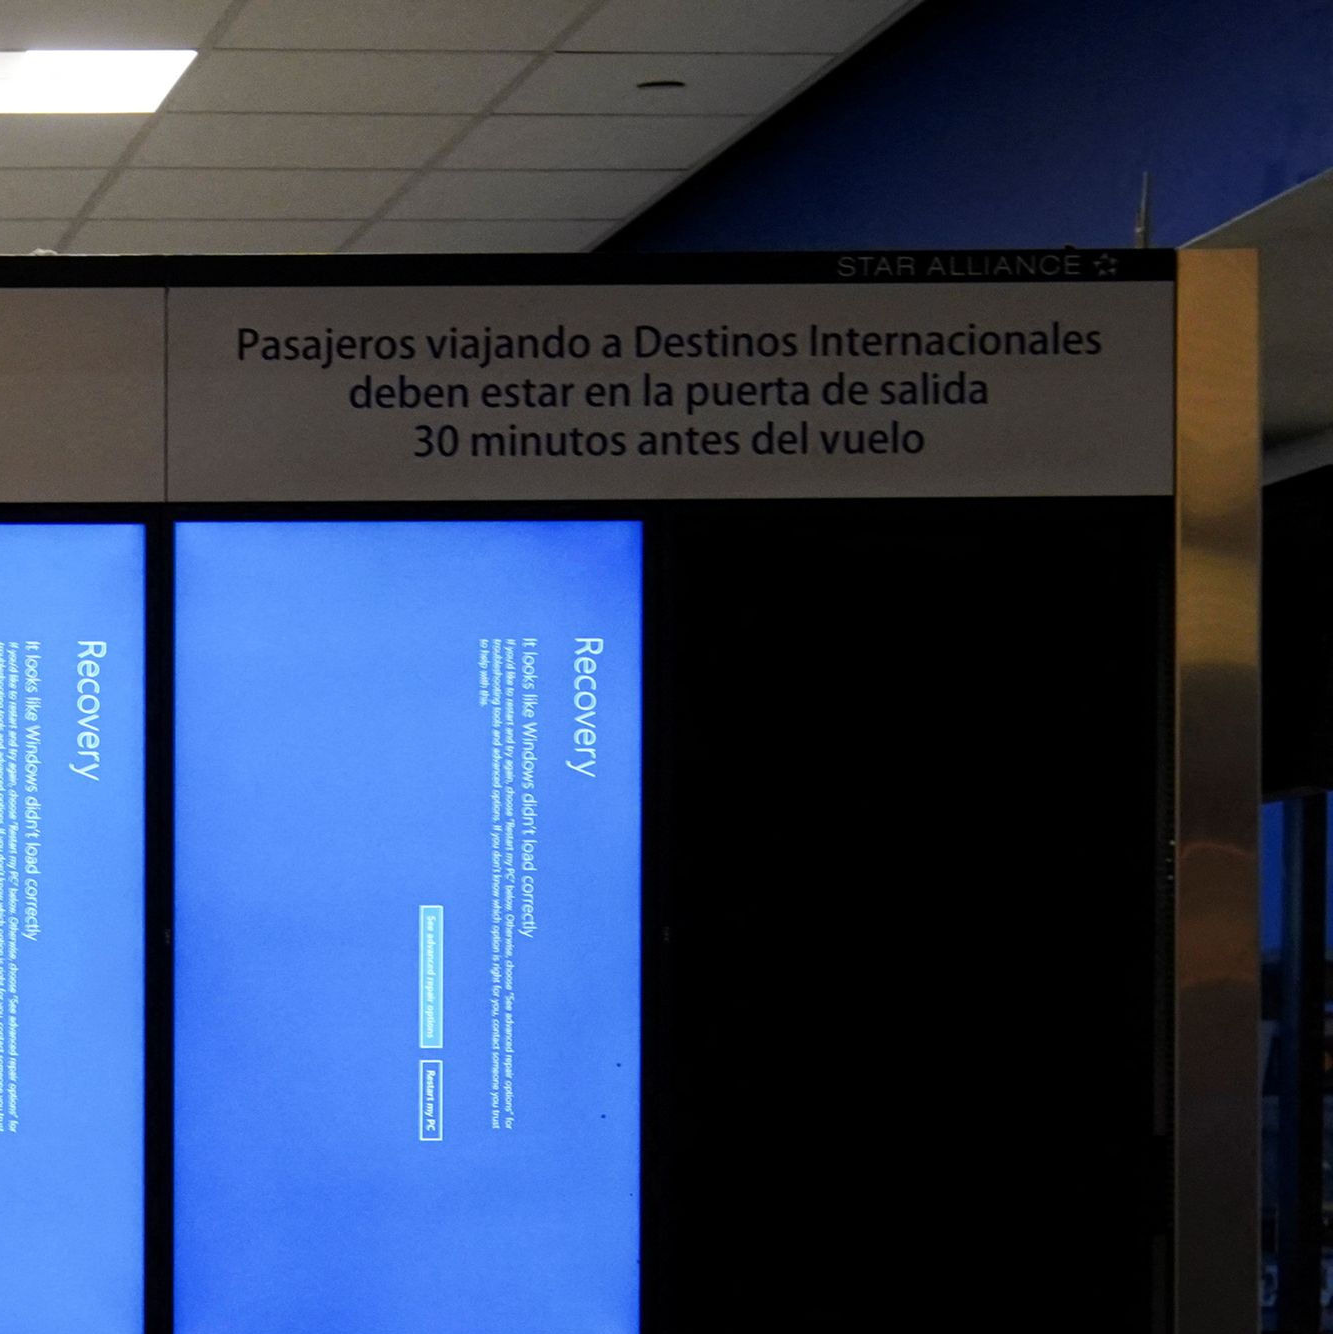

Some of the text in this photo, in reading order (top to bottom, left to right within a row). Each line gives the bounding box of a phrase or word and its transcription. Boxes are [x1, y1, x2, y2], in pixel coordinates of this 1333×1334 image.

[838, 256, 1080, 277] STAR ALLIANCE
[238, 321, 1102, 369] Pasajeros viajando a Destinos Internacionales
[350, 370, 988, 415] deben estar en la puerta de salida
[414, 420, 925, 457] 30 minutos antes del vuelo
[25, 641, 41, 651] It
[522, 638, 537, 647] It
[25, 655, 41, 692] looks
[522, 652, 538, 689] looks
[25, 697, 41, 721] like
[69, 641, 107, 780] Recovery
[522, 694, 538, 718] like
[565, 638, 604, 777] Recovery
[25, 725, 41, 792] Windows
[522, 722, 537, 789] Windows
[25, 842, 41, 874] load
[522, 840, 537, 871] load
[21, 878, 41, 941] correctly
[518, 876, 537, 938] correctly
[425, 915, 436, 1038] See advanced repair options
[426, 1070, 436, 1101] Restart
